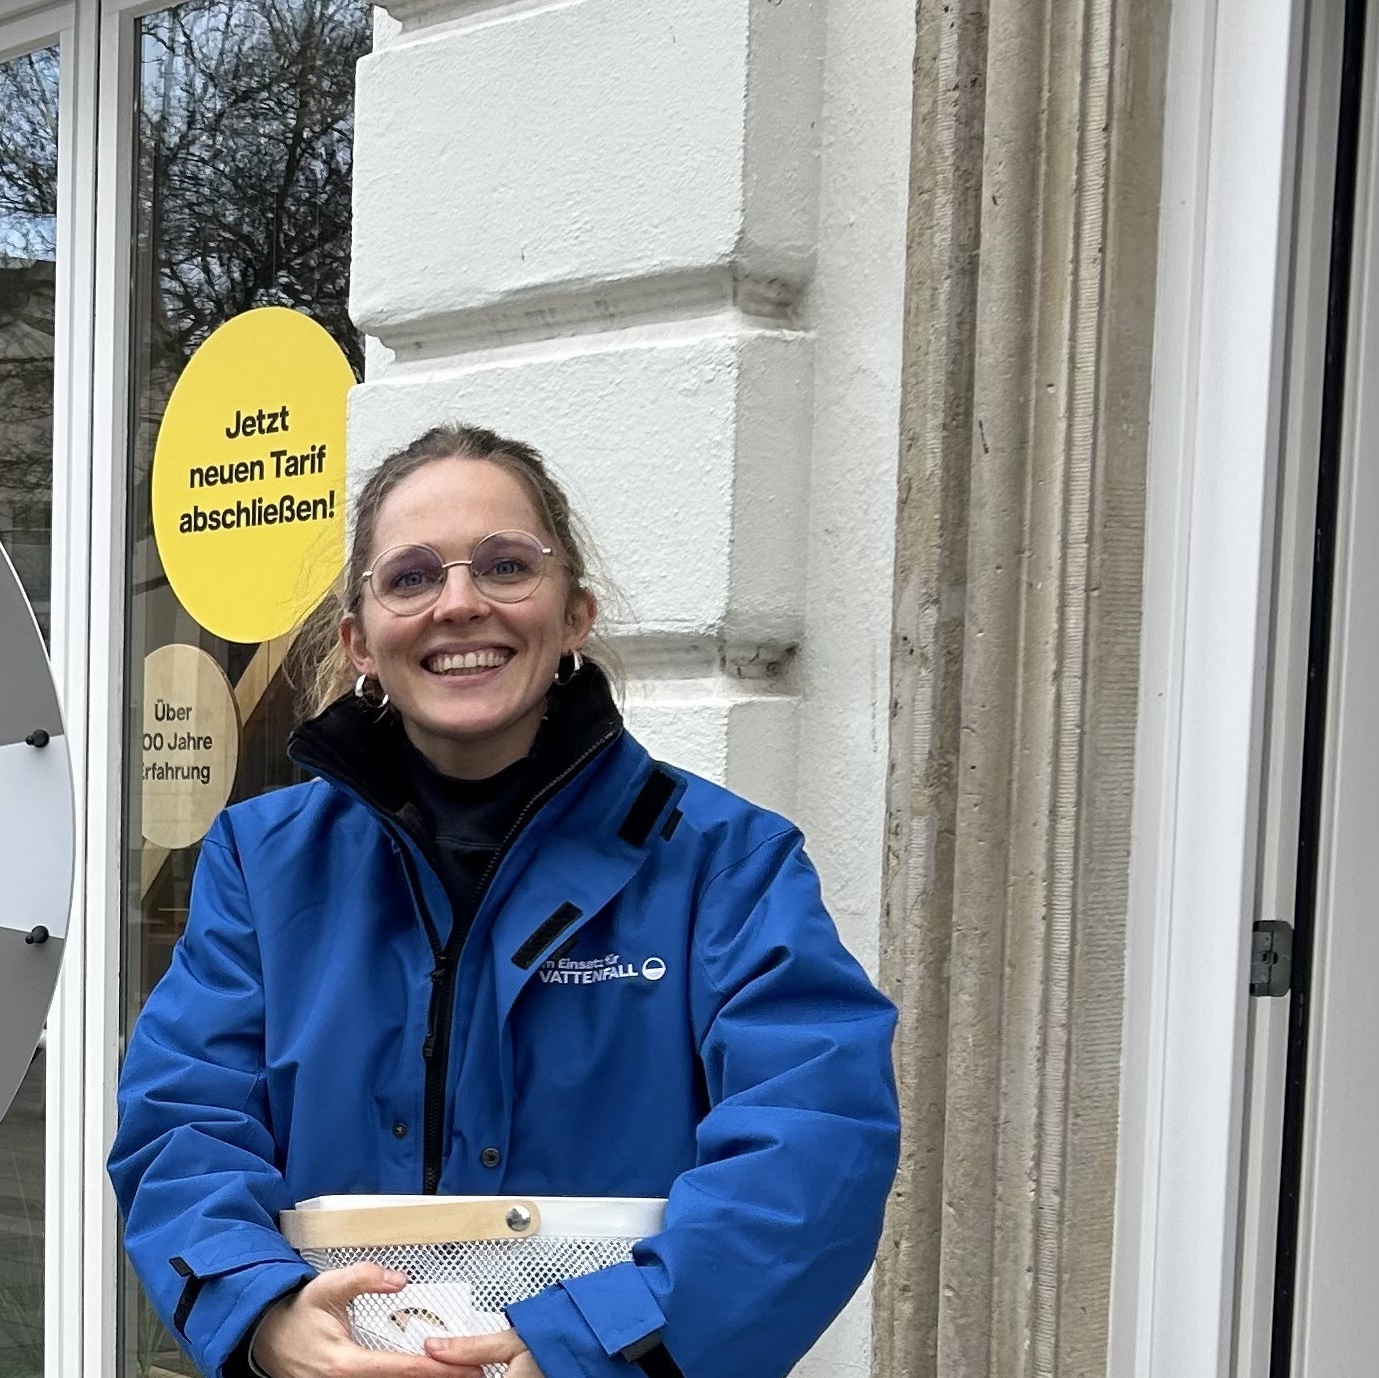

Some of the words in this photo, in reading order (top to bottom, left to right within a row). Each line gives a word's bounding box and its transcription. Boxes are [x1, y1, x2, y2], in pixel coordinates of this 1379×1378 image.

[225, 405, 290, 440] Jetzt
[189, 460, 265, 489] neuen
[270, 444, 327, 478] Tarif
[179, 490, 335, 534] abschließen!
[154, 699, 193, 722] Über
[142, 733, 164, 751] 00
[167, 732, 213, 751] Jahre
[538, 963, 639, 985] VATTENFALL
